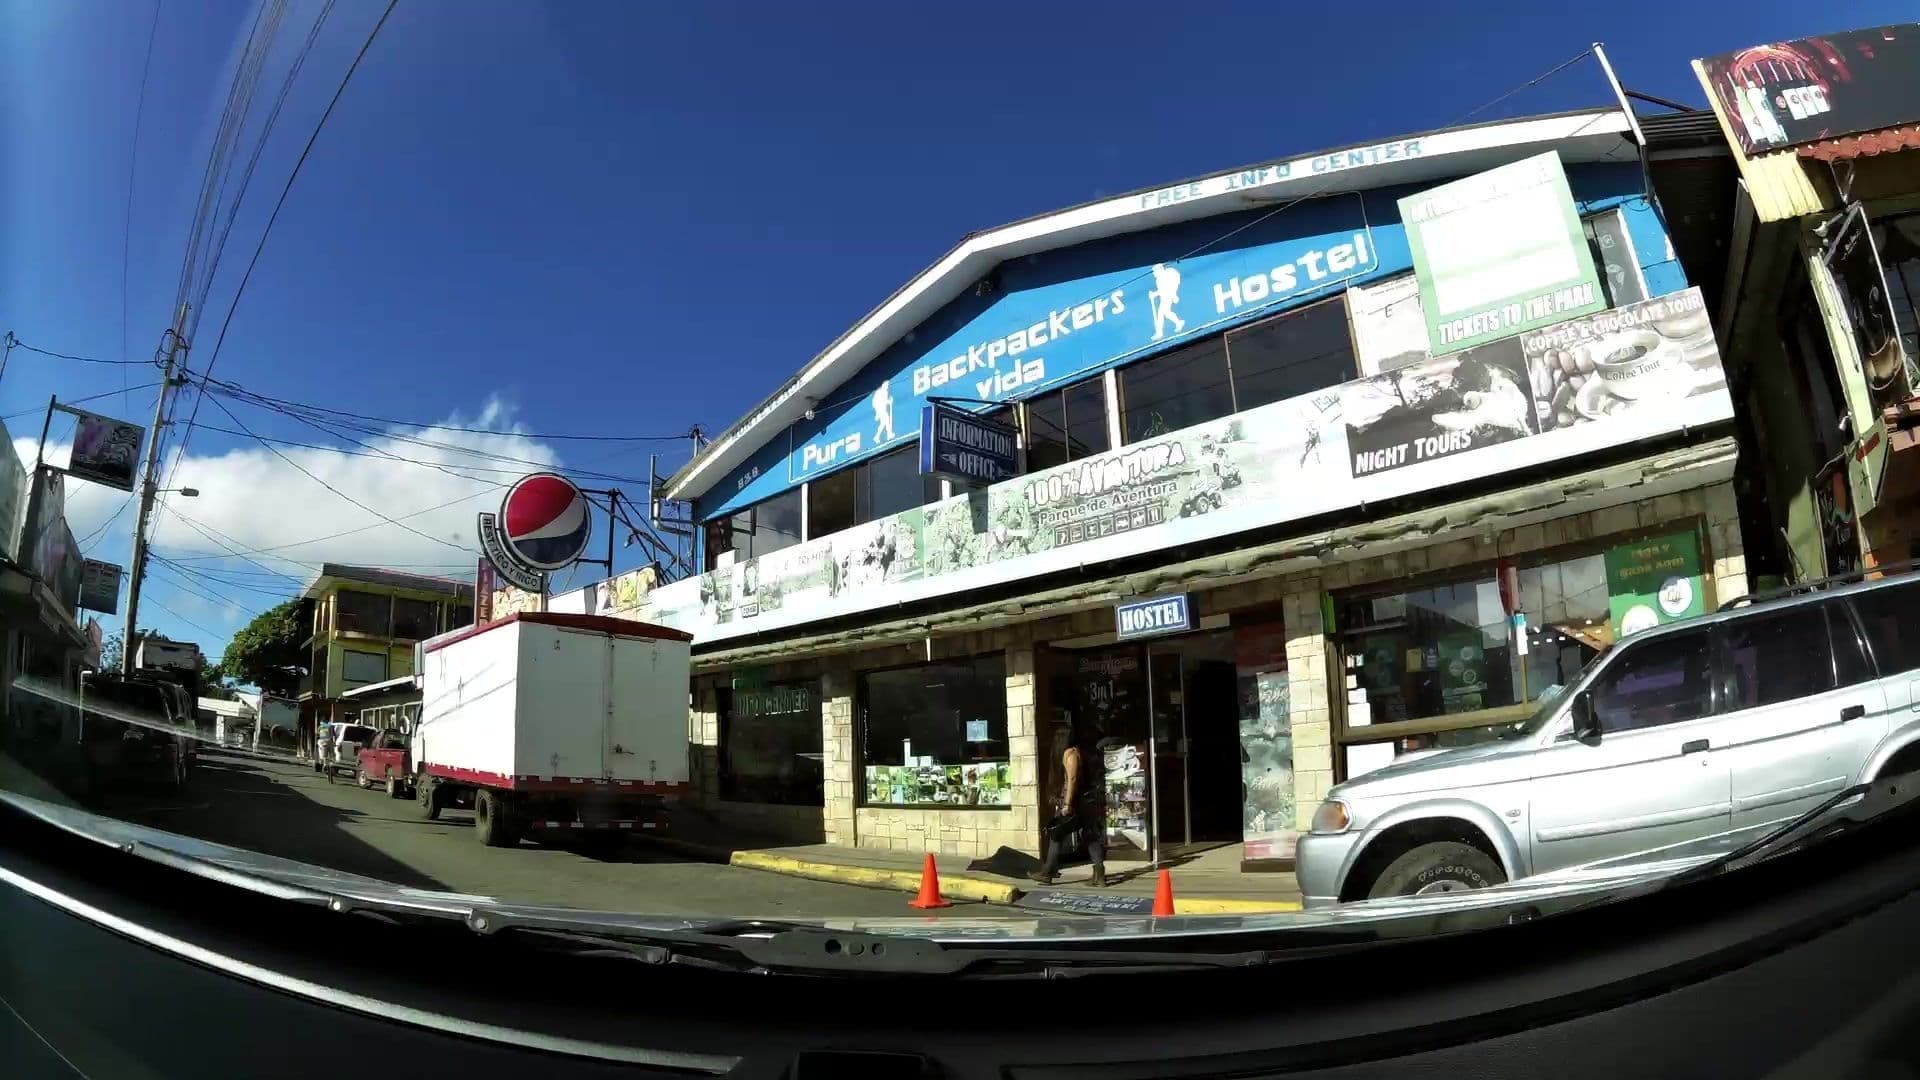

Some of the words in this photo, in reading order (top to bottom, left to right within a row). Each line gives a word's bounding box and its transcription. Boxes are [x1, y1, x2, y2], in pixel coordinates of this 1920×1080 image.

[1141, 181, 1203, 208] FREE
[1225, 163, 1291, 190] INFO
[1312, 140, 1422, 171] CENTER
[1214, 233, 1370, 313] Hostel
[1438, 309, 1500, 345] TICKETS
[1502, 303, 1521, 327] TO
[1523, 293, 1553, 321] THE
[1554, 281, 1595, 313] PARK
[1527, 324, 1577, 352] COFFEE
[1592, 305, 1666, 335] CHOCOLATE
[914, 289, 1126, 395] Backpackers
[976, 358, 1044, 400] vida
[1605, 367, 1637, 382] Coffee
[1638, 360, 1662, 377] Tour
[803, 432, 861, 470] Pura
[942, 417, 1012, 457] INFORMATION
[1355, 444, 1408, 475] NIGHT
[1414, 431, 1473, 459] TOURS
[959, 451, 996, 481] OFFICE
[1039, 505, 1086, 524] Parque
[1090, 499, 1107, 512] de
[1112, 482, 1177, 506] Aventura
[1121, 601, 1183, 632] HOSTEL
